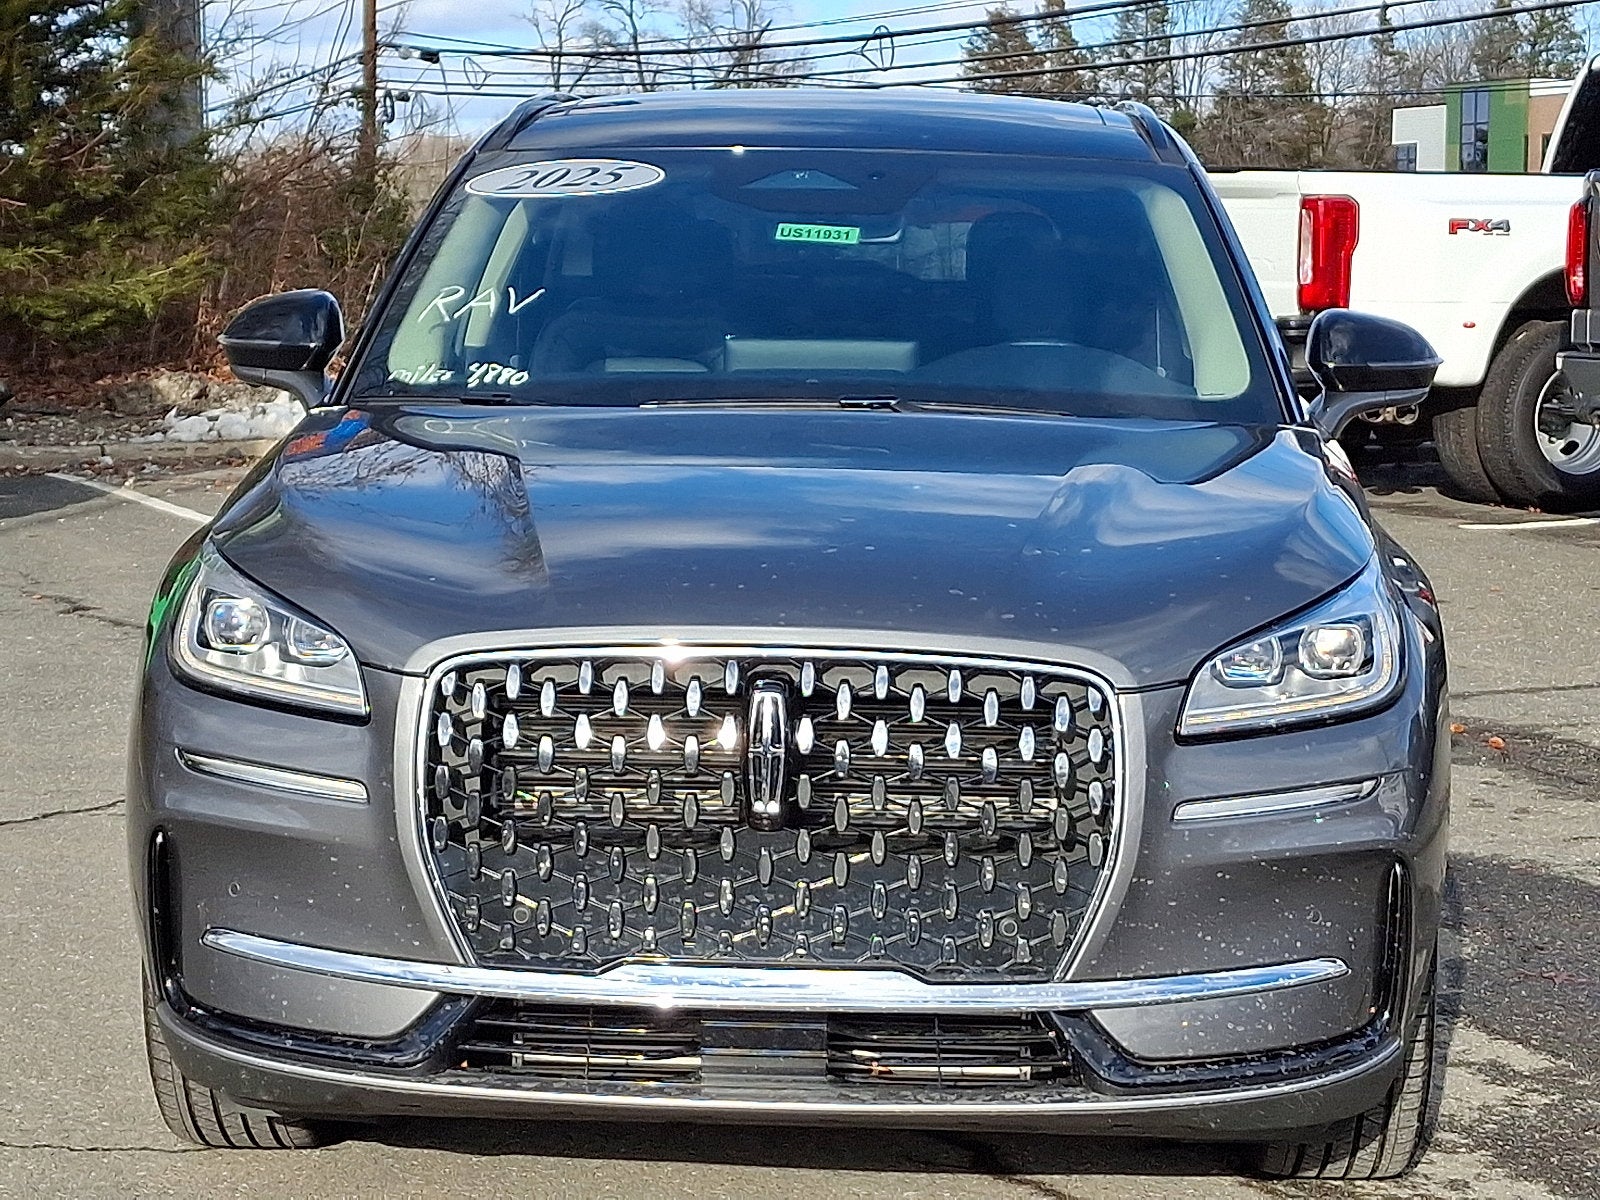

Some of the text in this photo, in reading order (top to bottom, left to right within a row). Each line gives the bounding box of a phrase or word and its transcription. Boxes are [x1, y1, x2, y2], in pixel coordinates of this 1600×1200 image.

[496, 166, 636, 191] 2025
[780, 227, 850, 240] US11931
[1449, 218, 1511, 234] FX4
[417, 285, 546, 322] RAV
